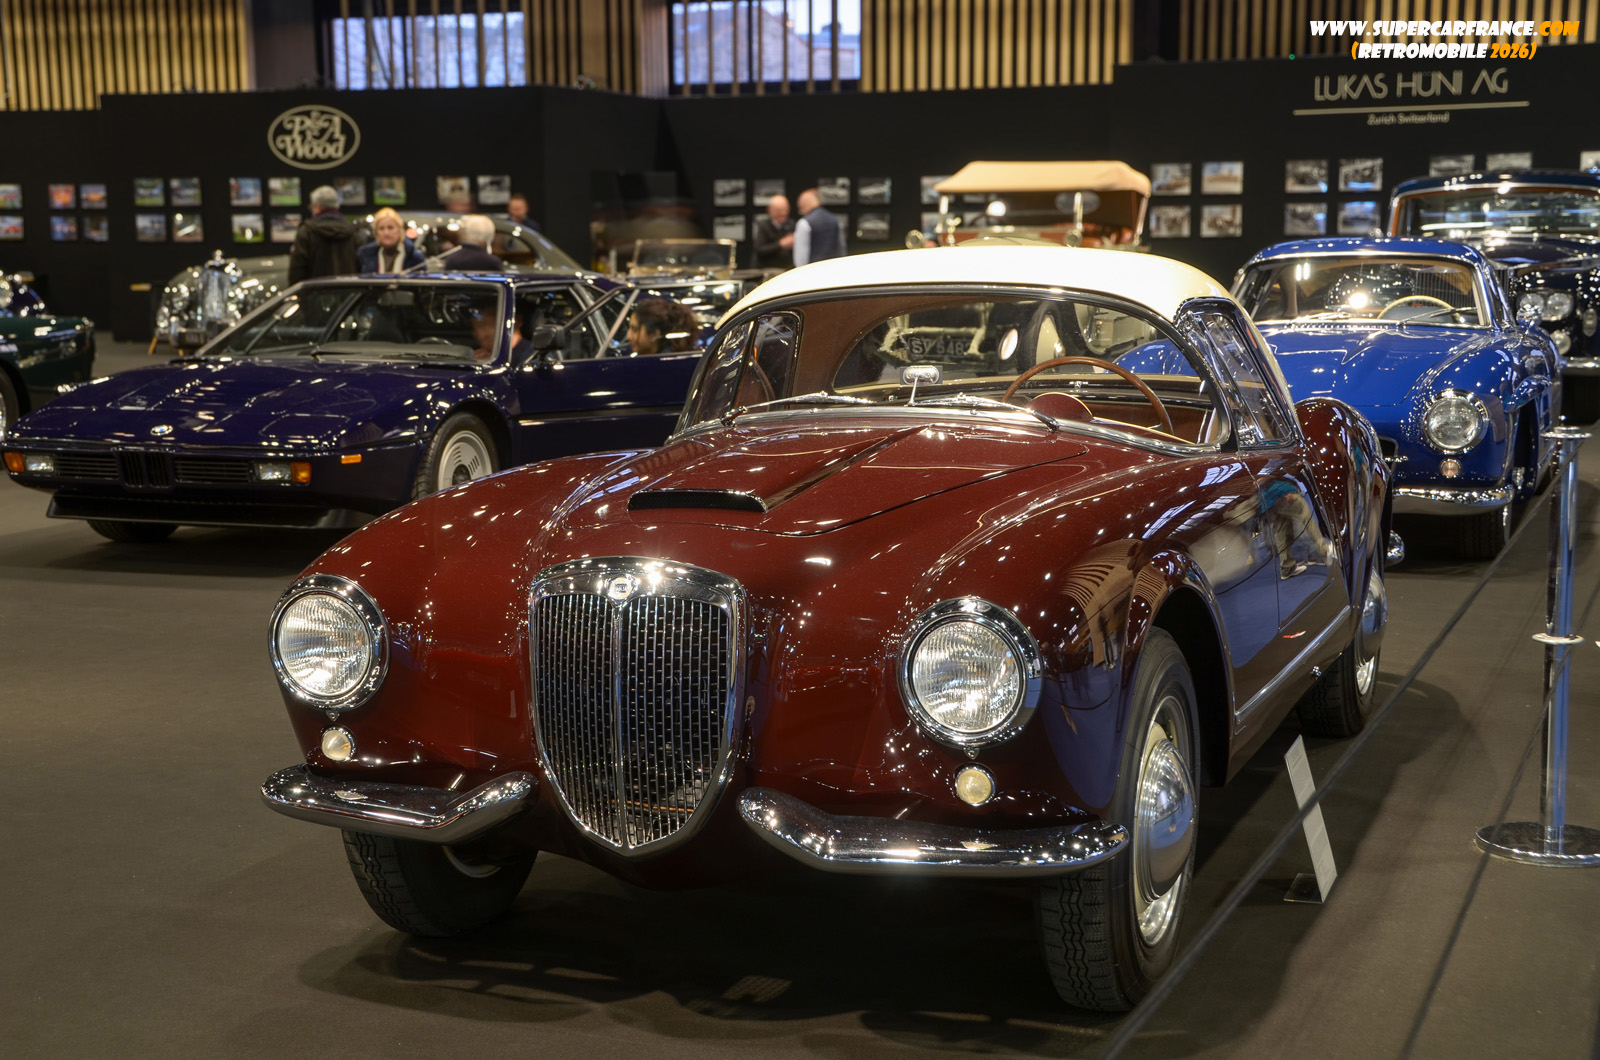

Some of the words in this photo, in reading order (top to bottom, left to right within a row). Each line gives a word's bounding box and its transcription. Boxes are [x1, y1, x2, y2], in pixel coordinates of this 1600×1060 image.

[1314, 72, 1388, 101] LUKAS
[1471, 67, 1508, 95] AG
[275, 134, 346, 159] Wood
